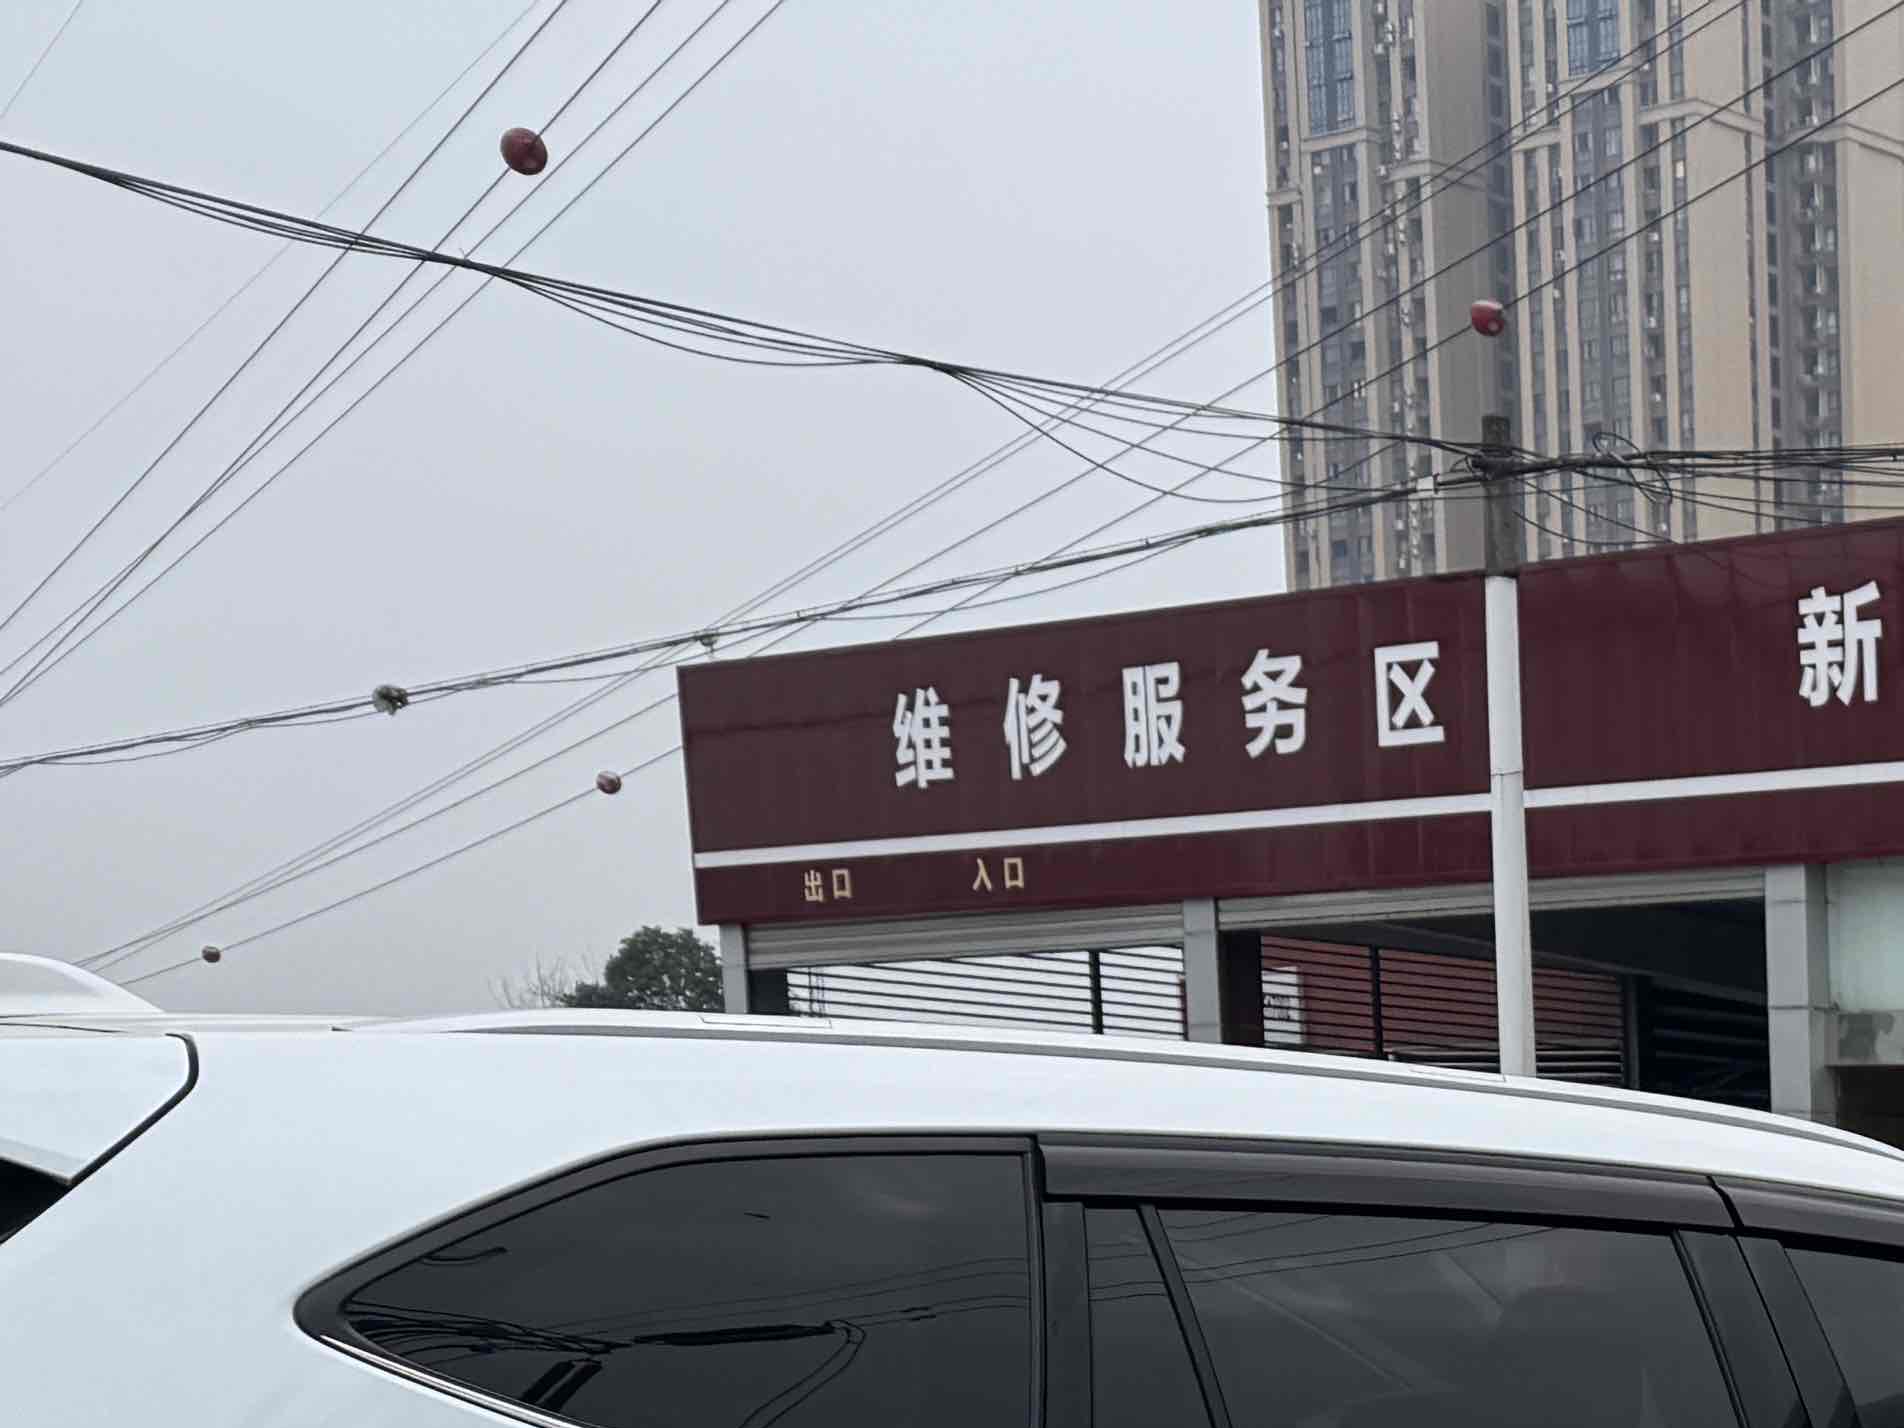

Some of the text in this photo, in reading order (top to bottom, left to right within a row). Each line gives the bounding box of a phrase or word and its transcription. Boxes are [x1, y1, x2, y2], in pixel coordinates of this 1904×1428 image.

[893, 641, 1446, 789] 维修服务区
[804, 857, 1025, 902] 出口 入口
